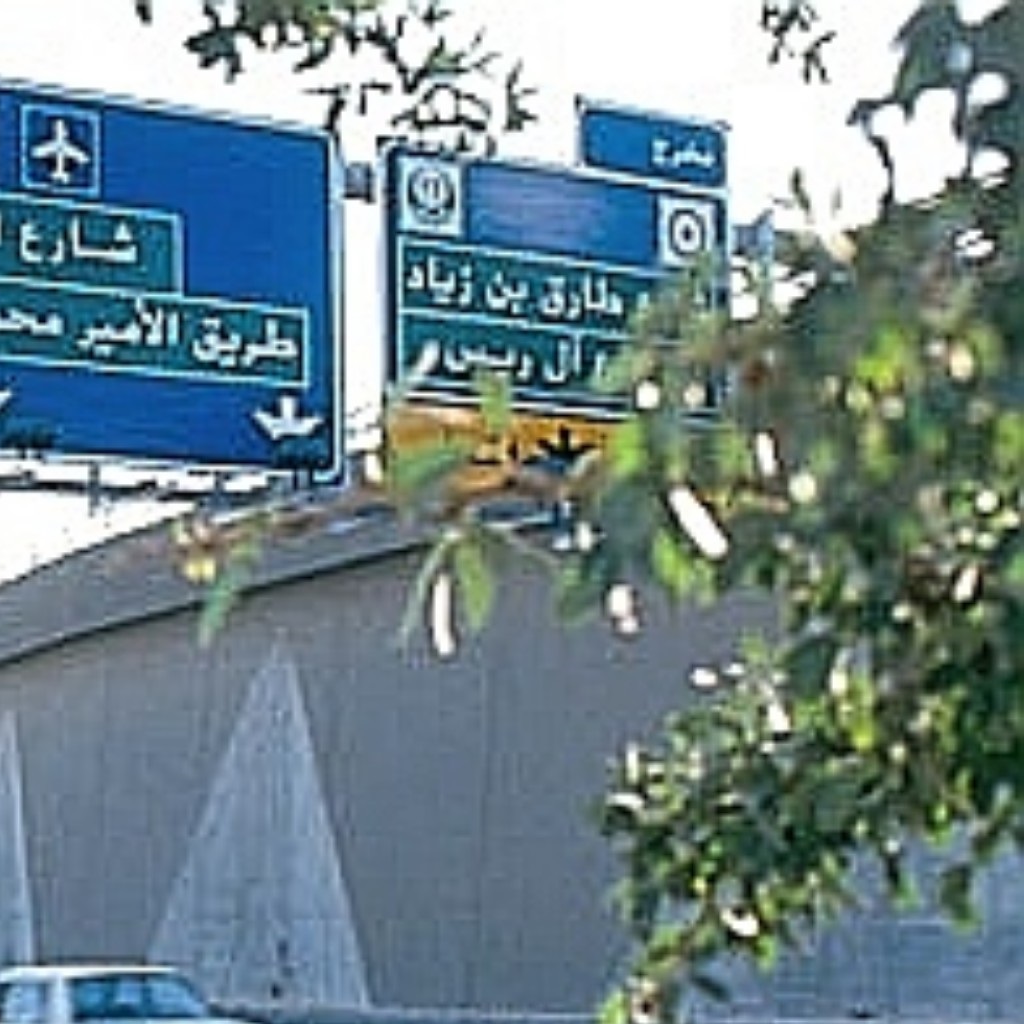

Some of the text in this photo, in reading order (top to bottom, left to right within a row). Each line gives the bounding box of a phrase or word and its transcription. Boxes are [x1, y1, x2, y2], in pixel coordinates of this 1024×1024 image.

[19, 219, 138, 264] شارع
[406, 255, 624, 321] طارق بن زياد
[74, 297, 179, 356] الأمير
[190, 316, 300, 368] طريق
